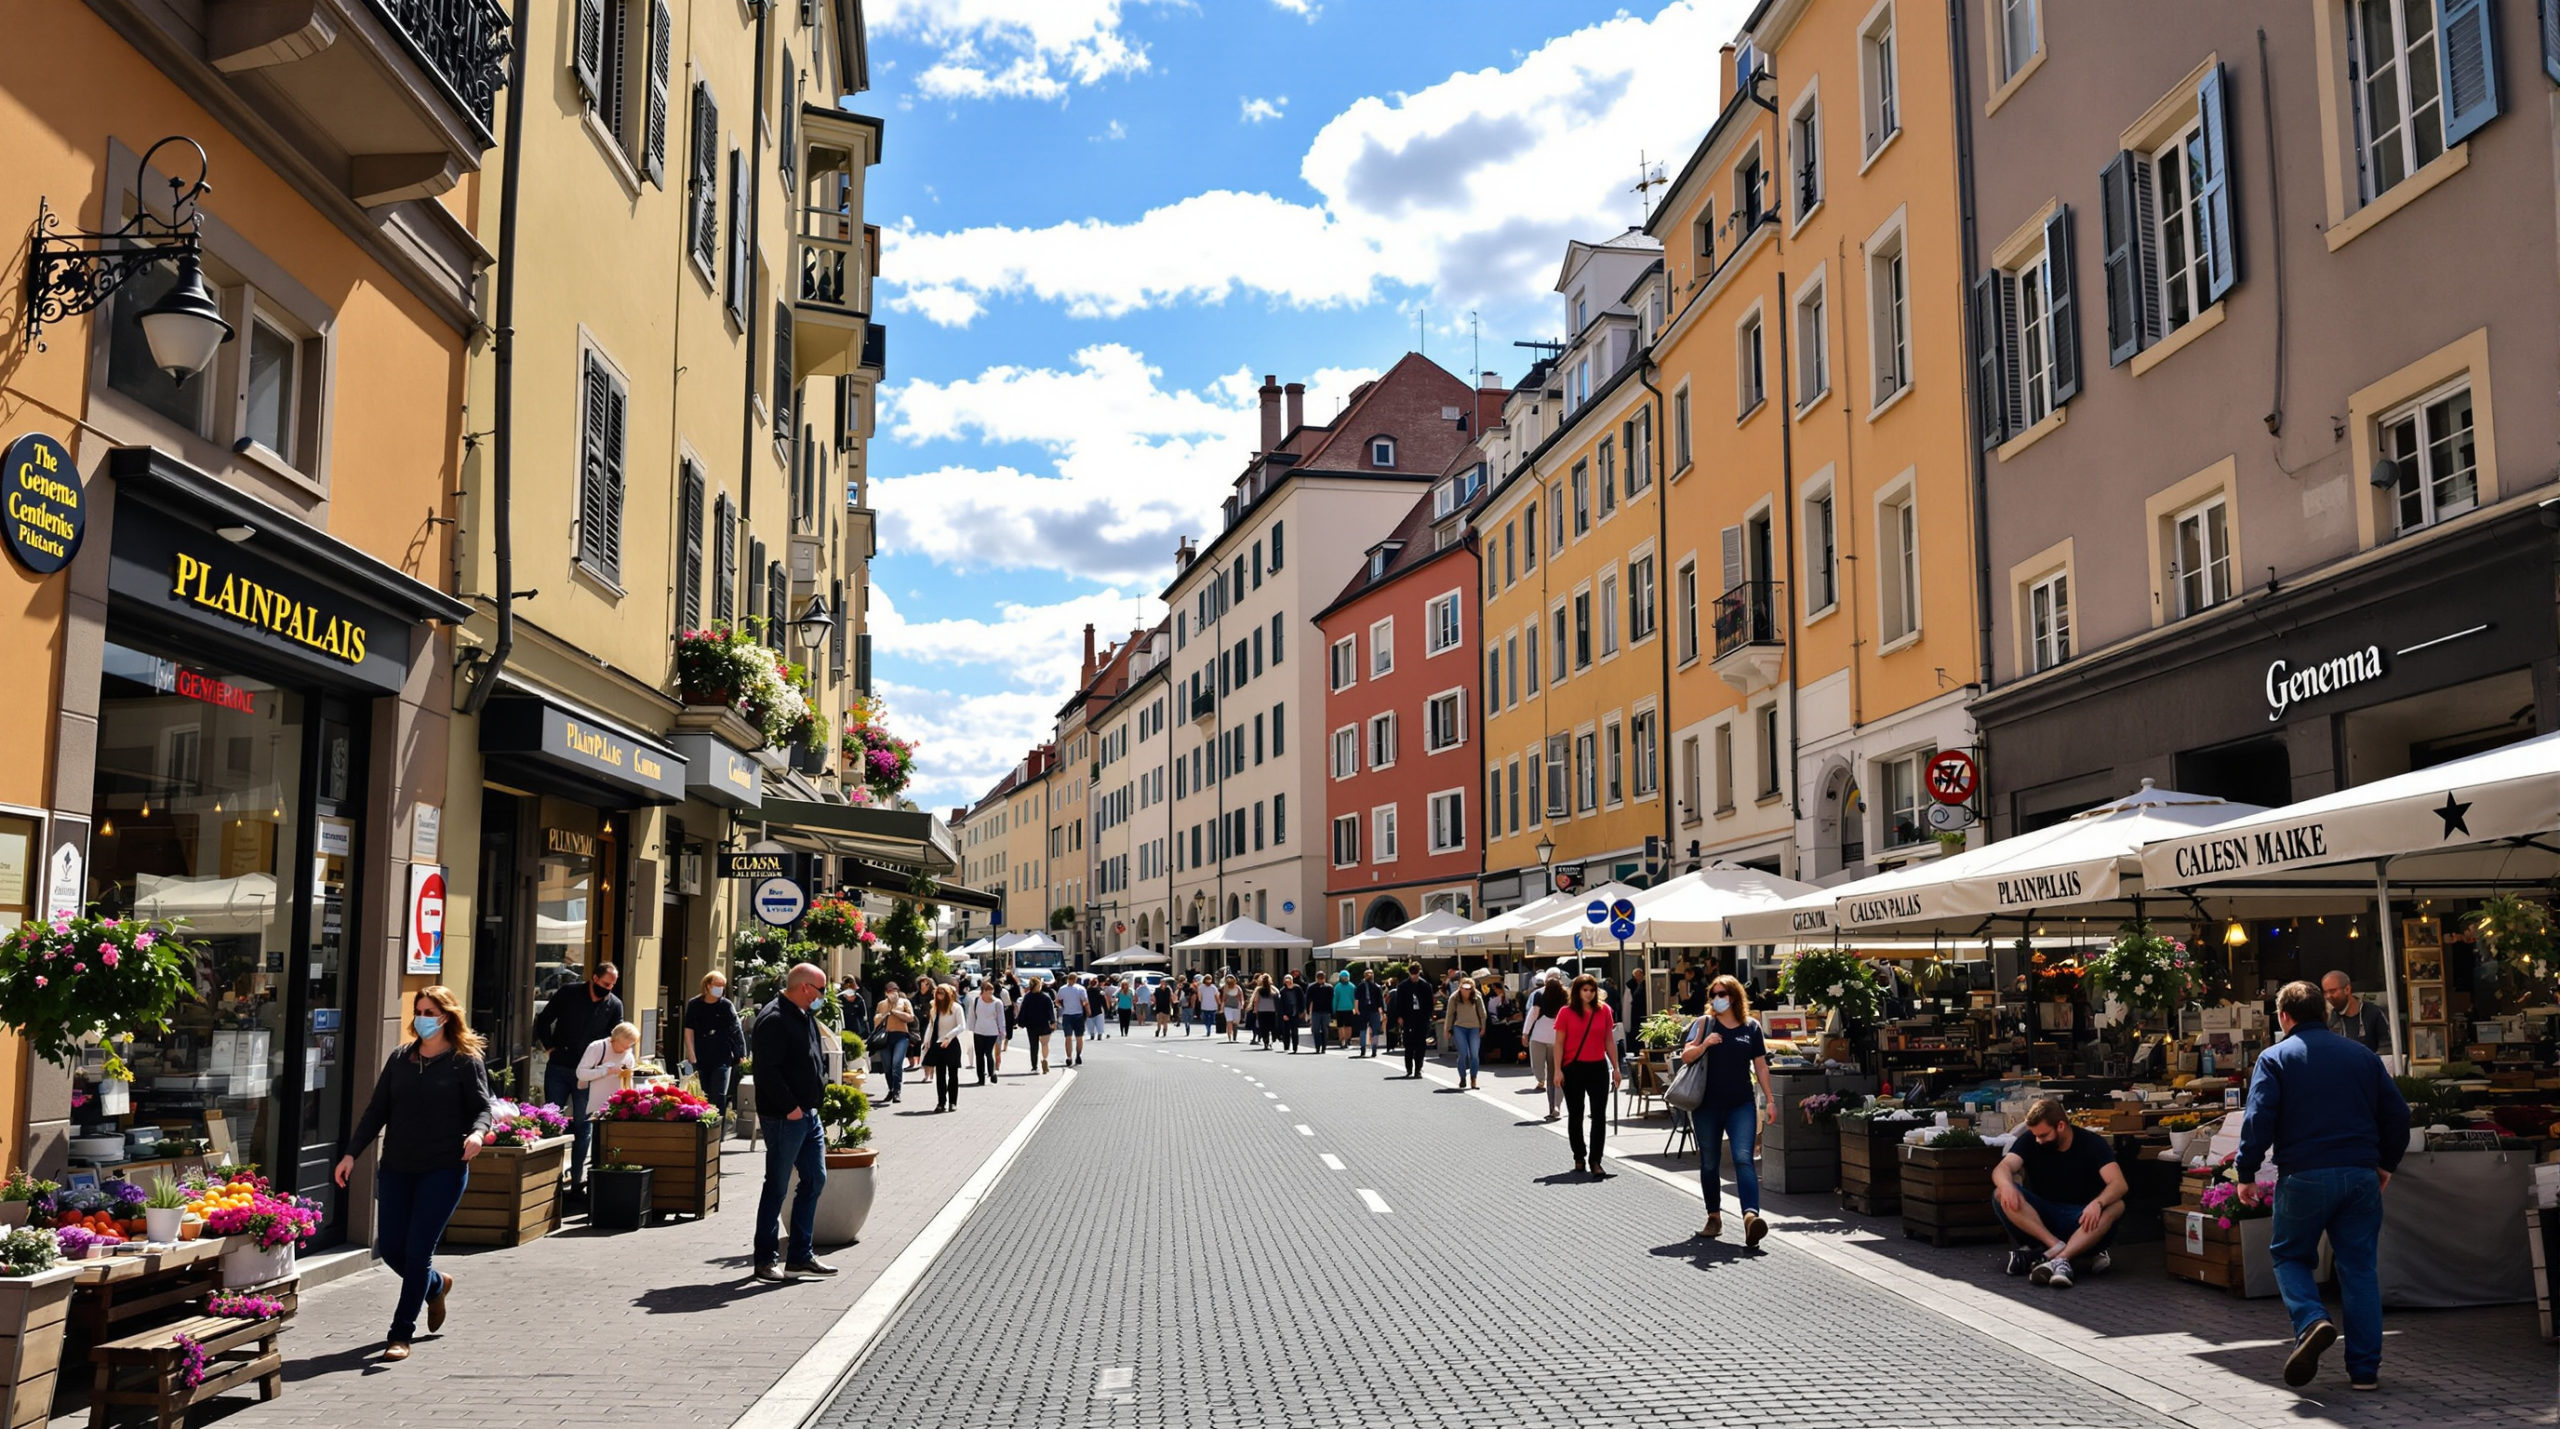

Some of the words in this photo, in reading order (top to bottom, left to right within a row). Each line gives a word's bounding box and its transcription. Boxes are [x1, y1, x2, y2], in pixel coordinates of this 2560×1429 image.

[34, 443, 58, 472] The
[173, 553, 366, 664] PLAINPALAIS
[2175, 836, 2249, 878] CALESN
[1998, 870, 2082, 904] PLAINPALAIS
